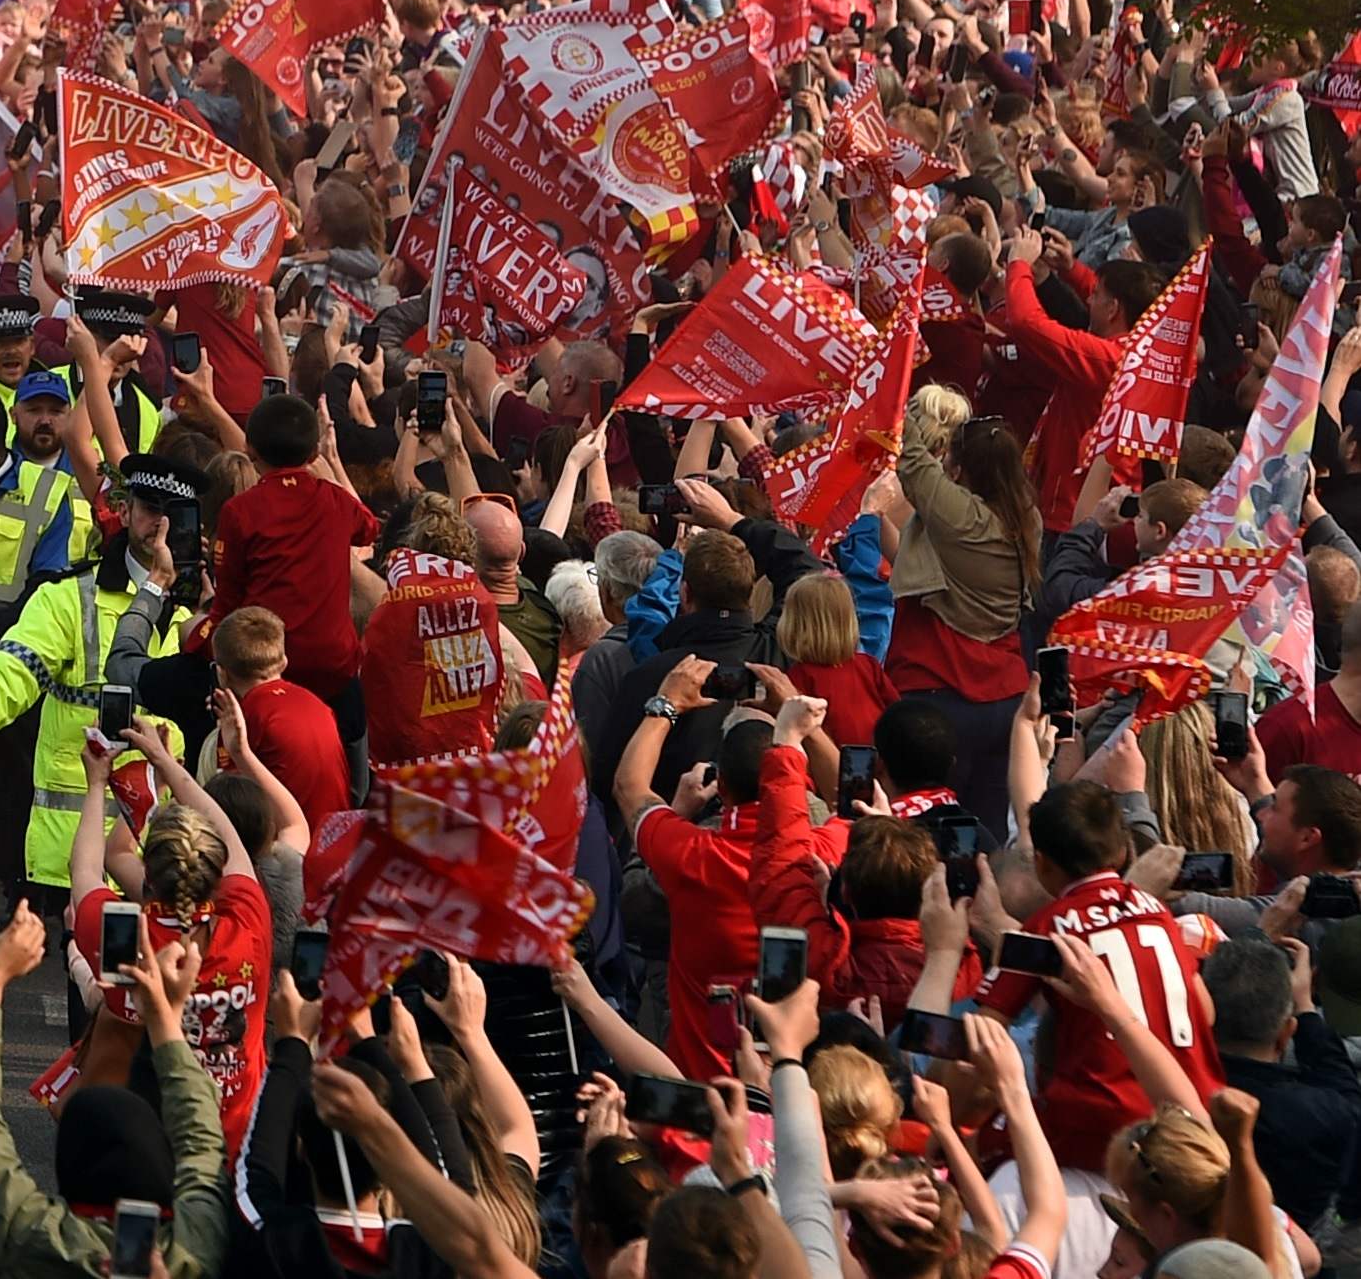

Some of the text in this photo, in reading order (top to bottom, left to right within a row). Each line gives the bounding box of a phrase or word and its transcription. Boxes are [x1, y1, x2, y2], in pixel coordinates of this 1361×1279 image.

[633, 126, 682, 181] MADRID
[509, 158, 552, 196] GOING
[465, 181, 532, 243] WE'RE
[505, 296, 546, 335] MADRID
[417, 597, 482, 639] ALLEZ
